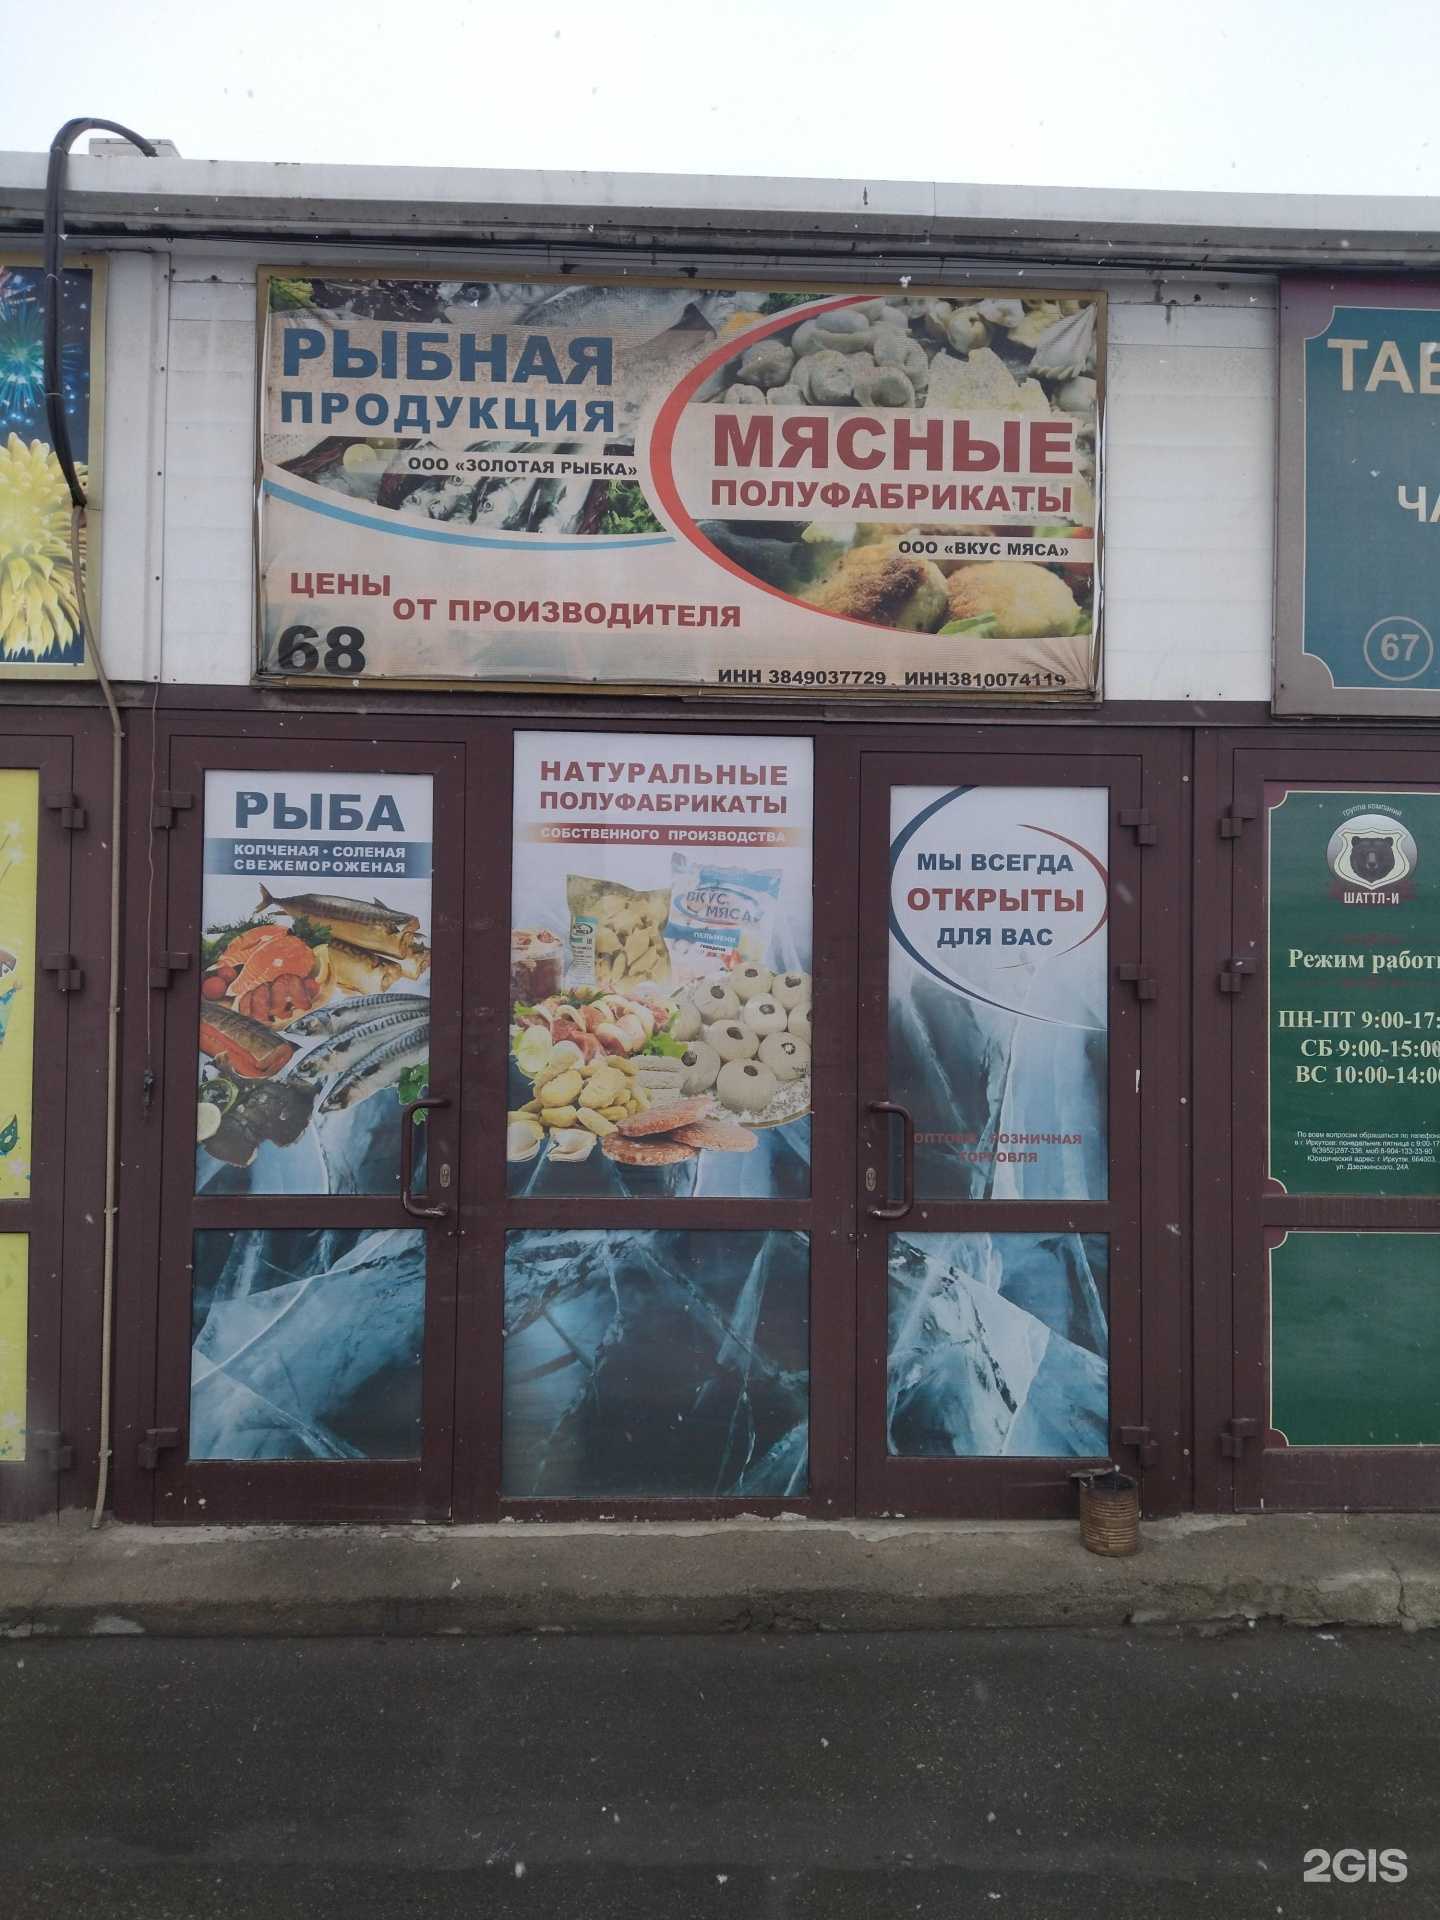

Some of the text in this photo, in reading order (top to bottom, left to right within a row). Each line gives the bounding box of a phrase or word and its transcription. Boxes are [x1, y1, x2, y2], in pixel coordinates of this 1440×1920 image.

[283, 328, 613, 385] РЫБНАЯ
[280, 391, 614, 438] ПРОДУКЦИЯ
[713, 414, 1073, 474] МЯСНЫЕ
[408, 457, 637, 476] ООО «ЗОЛОТАЯ РЫБКА»
[711, 479, 1071, 513] ПОЛУФАБРИКАТЫ
[1398, 485, 1440, 523] Ч
[898, 541, 1069, 557] ООО «ВКУС МЯСА»
[290, 572, 391, 599] ЦЕНЫ
[392, 598, 741, 628] ОТ ПРОИЗВОДИТЕЛЯ
[277, 624, 366, 674] 68
[1380, 634, 1420, 662] 67
[718, 668, 1066, 687] ИНН 3849037729 ИНН3810074119
[540, 761, 788, 786] НАТУРАЛЬНЫЕ
[235, 791, 405, 832] РЫБА
[540, 791, 787, 814] ПОЛУФАБРИКАТЫ
[541, 828, 785, 843] СОБСТВЕННОГО ПРОИЗВОДСТВА
[234, 844, 406, 858] КОПЧЕНАЯ СОЛЕНАЯ
[234, 859, 406, 873] СВЕЖЕМОРОЖЕНАЯ
[917, 853, 1074, 875] МЫ ВСЕГДА
[907, 887, 1084, 912] ОТКРЫТЫ
[1343, 892, 1400, 904] ШАТТЛ-И
[937, 927, 1053, 948] ДЛЯ ВАС
[1288, 949, 1440, 974] Режим работ
[1279, 1010, 1356, 1028] ПН-ПТ
[1300, 1039, 1333, 1057] СБ
[1295, 1066, 1440, 1084] ВС 10:00-14:0
